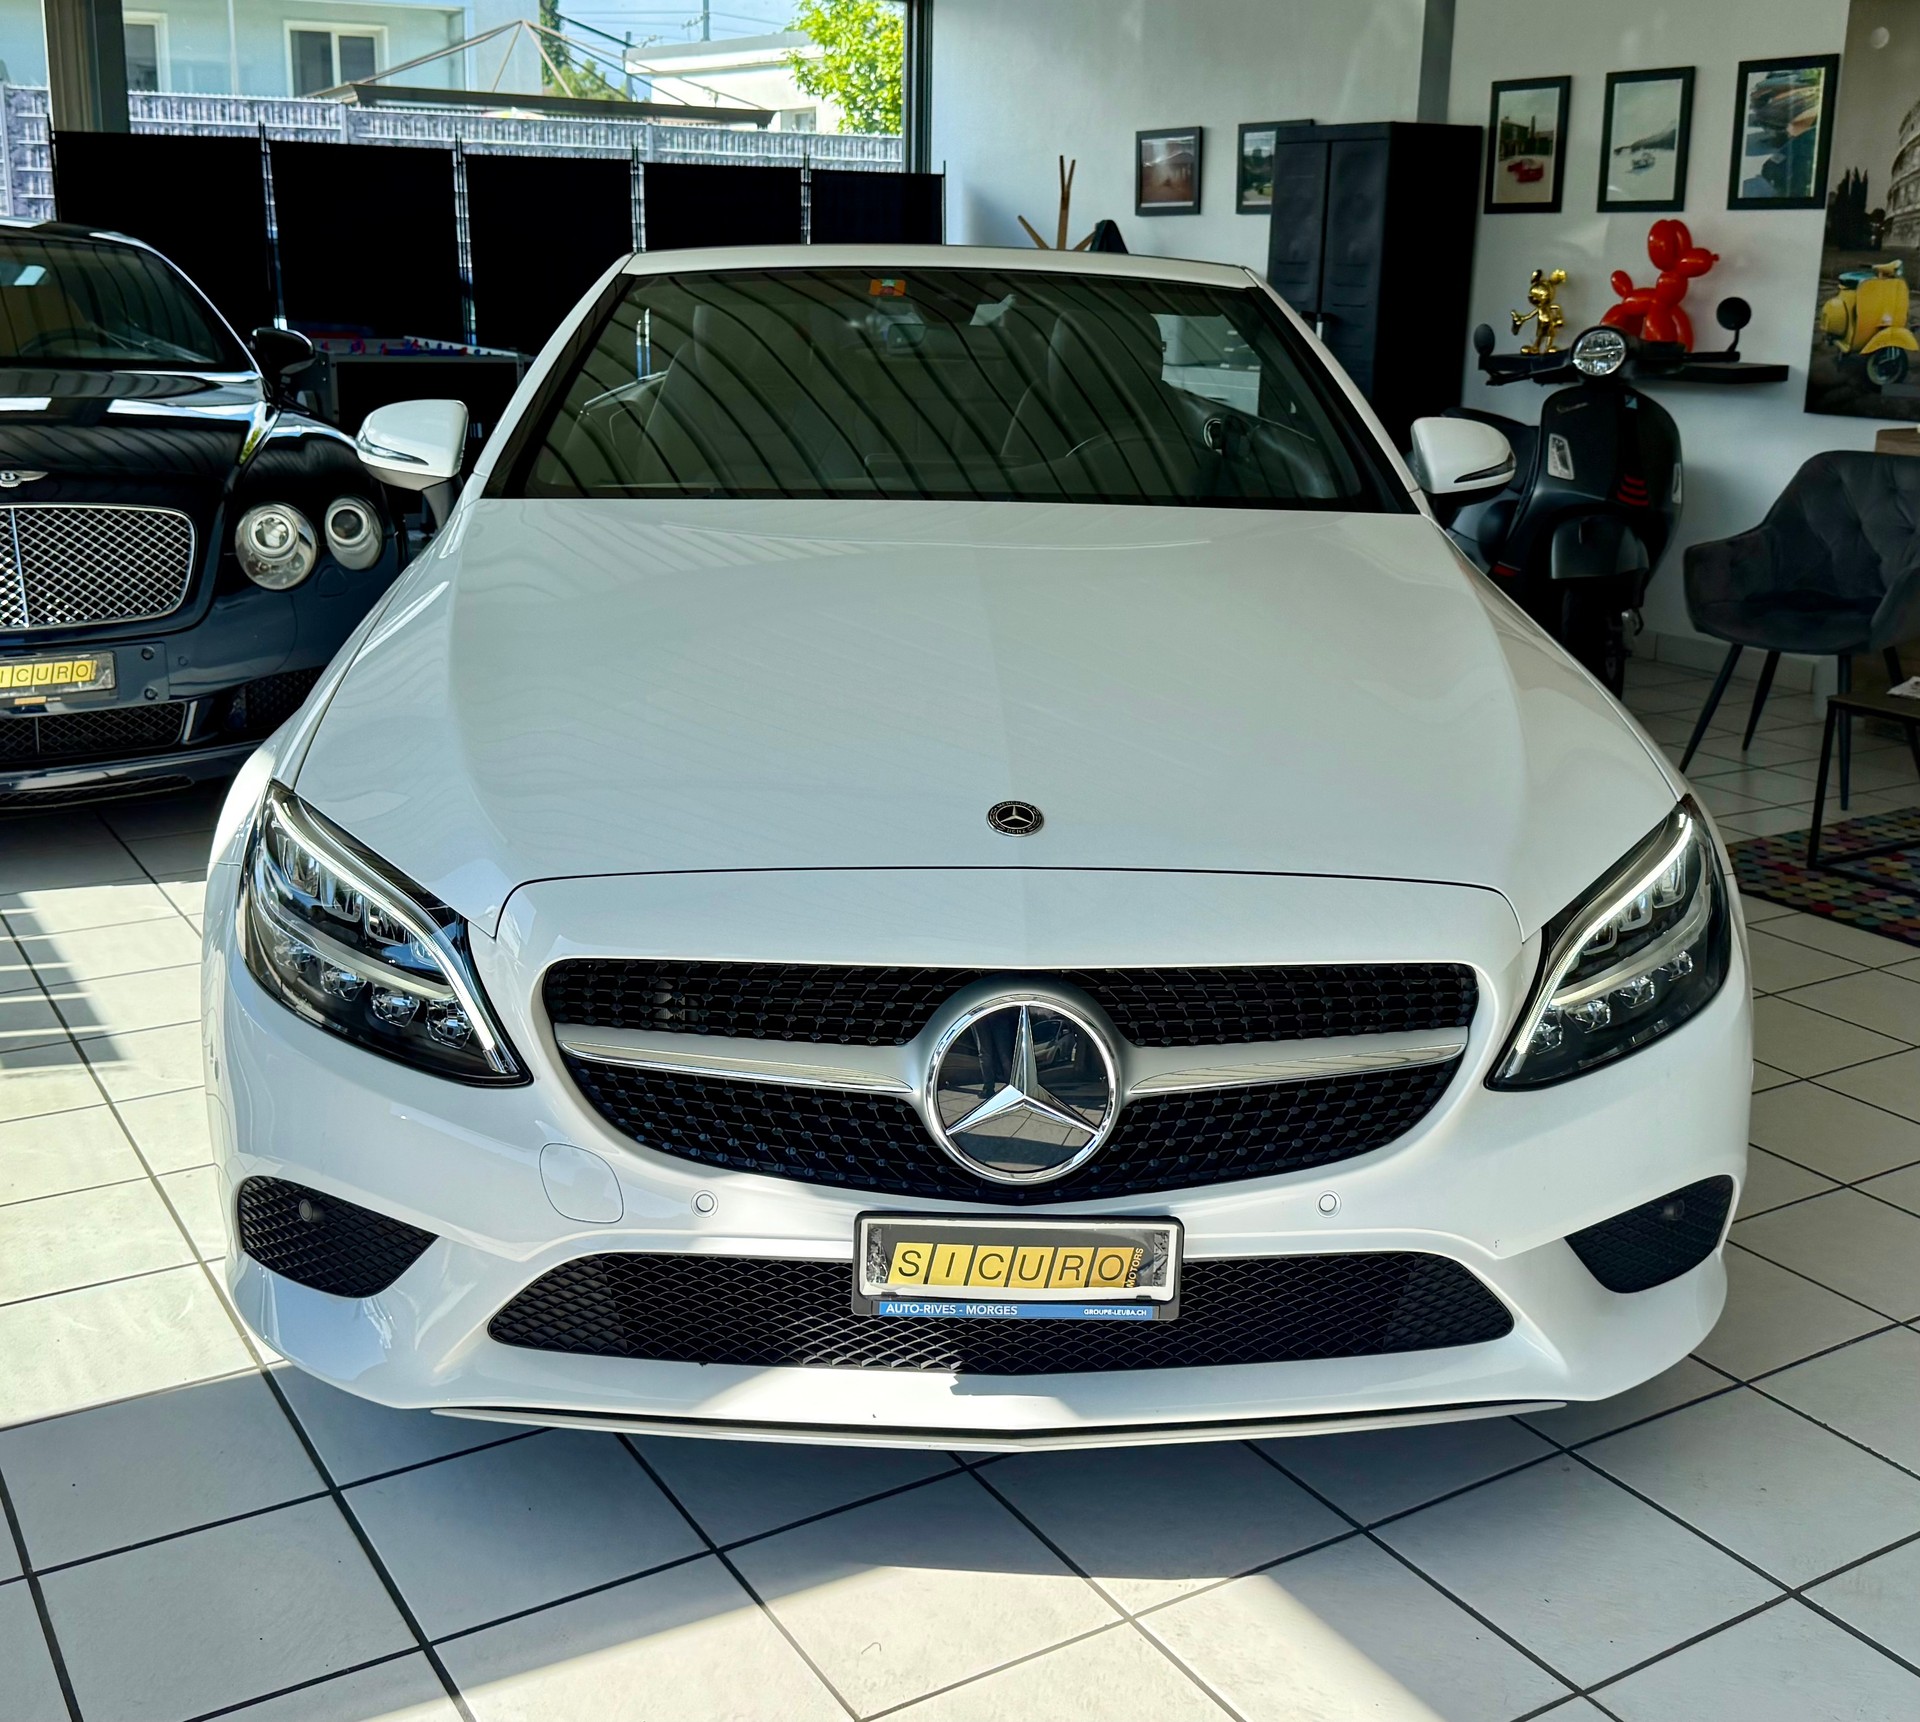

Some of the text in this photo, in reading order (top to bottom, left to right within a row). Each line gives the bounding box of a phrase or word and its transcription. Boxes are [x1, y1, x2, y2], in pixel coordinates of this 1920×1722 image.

[898, 1249, 1124, 1281] SICURO
[1125, 1247, 1144, 1288] MOTORS
[886, 1303, 956, 1314] AUTO-RIVES
[966, 1305, 1018, 1315] MORGES
[1083, 1308, 1147, 1316] GROUPE-LEUBA.CH
